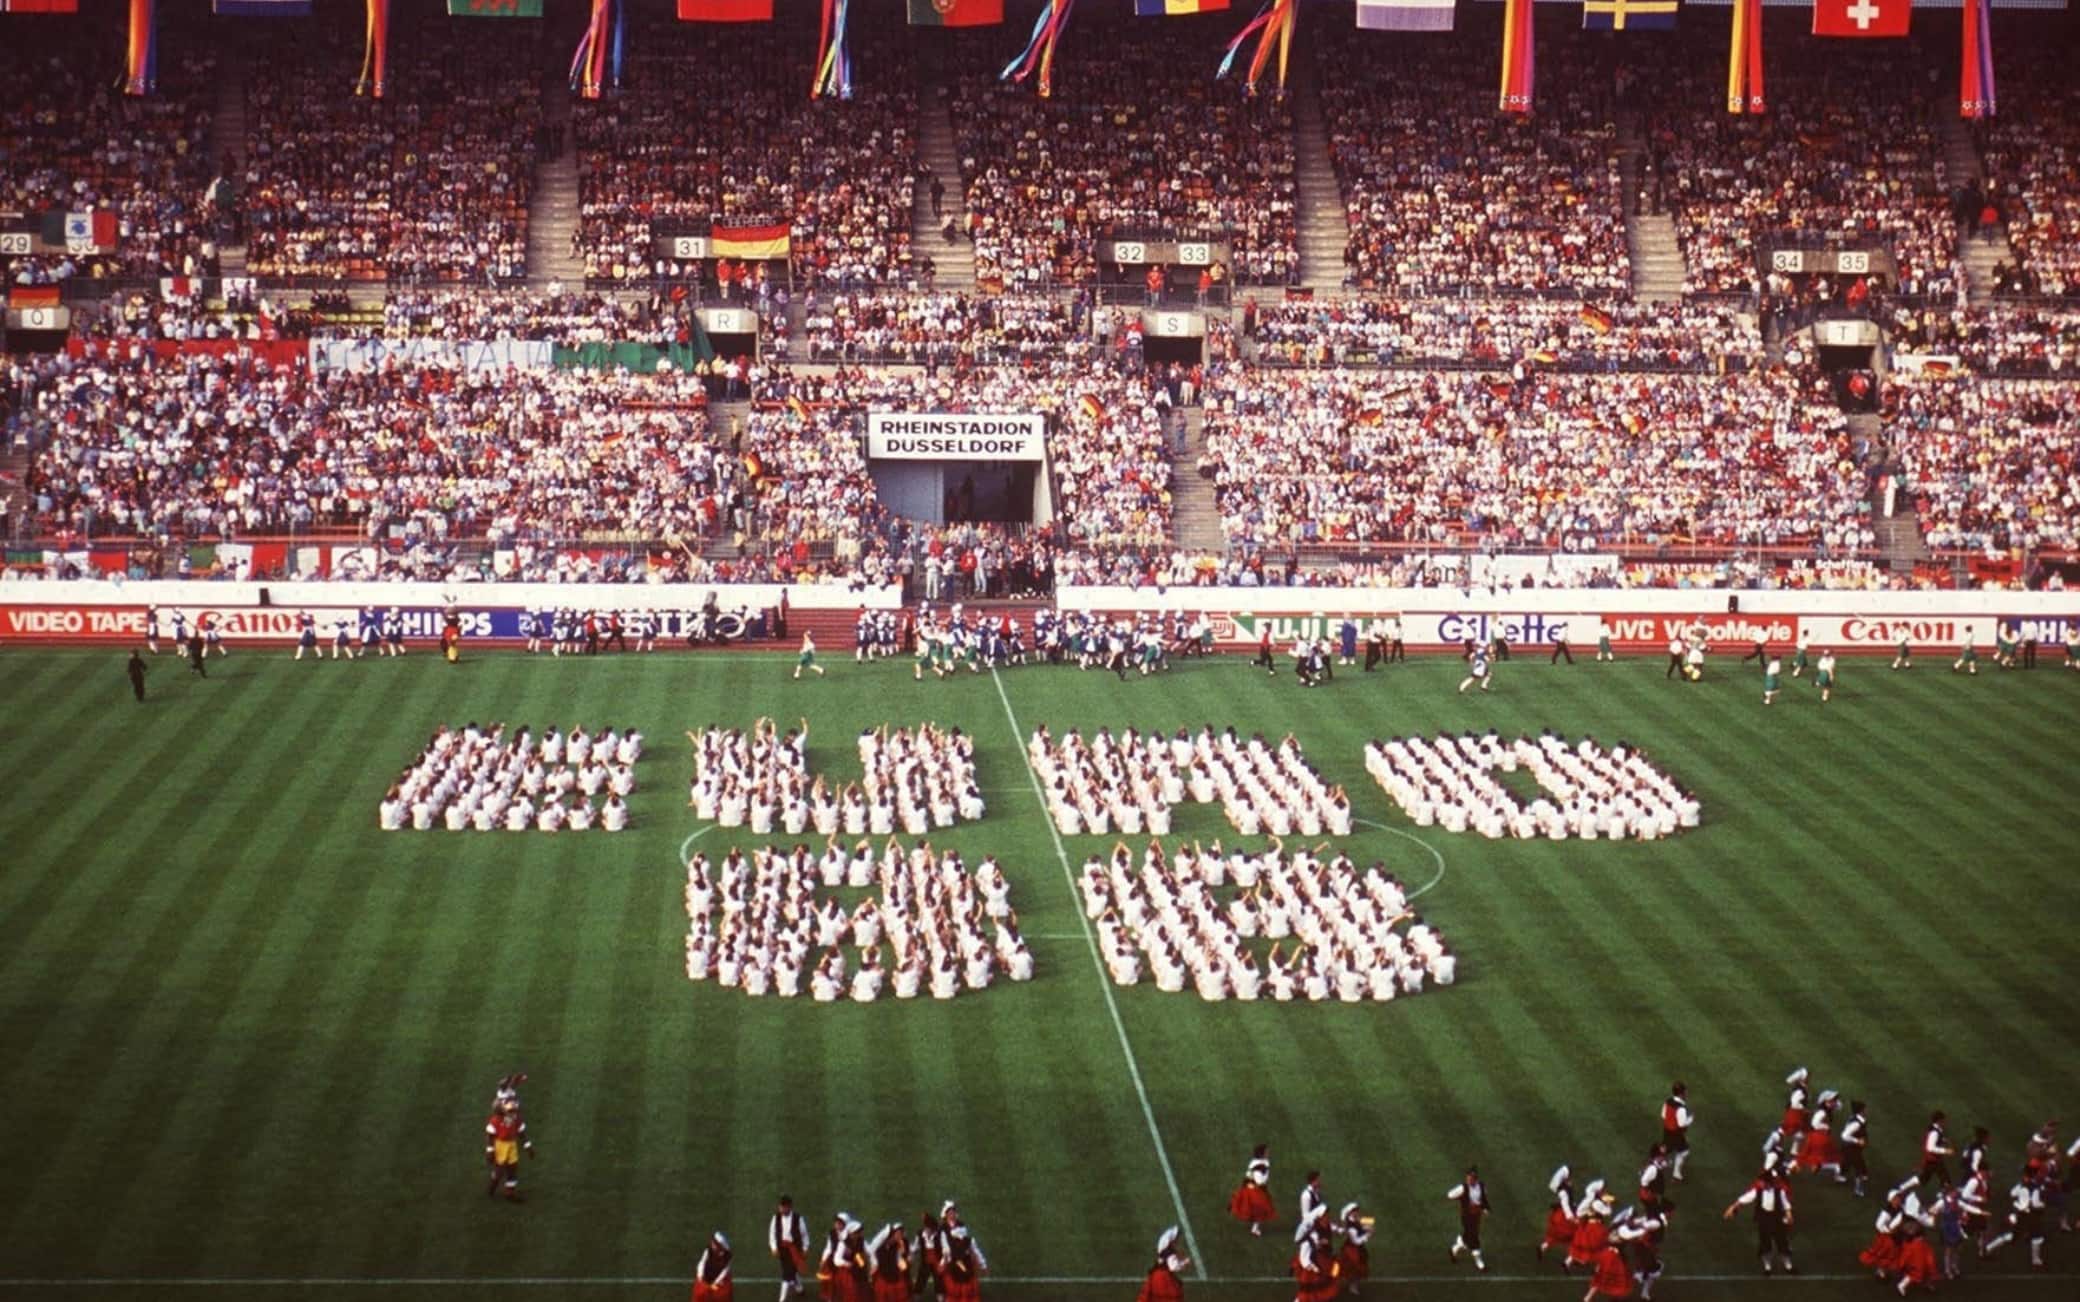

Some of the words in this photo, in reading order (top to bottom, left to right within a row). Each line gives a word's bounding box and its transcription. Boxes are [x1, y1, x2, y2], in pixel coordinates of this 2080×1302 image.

[3, 236, 28, 252] 29
[680, 240, 700, 255] 31
[1118, 245, 1141, 260] 32
[1183, 246, 1206, 261] 33
[1776, 255, 1798, 269] 34
[1842, 257, 1865, 271] 35
[31, 309, 44, 326] Q
[717, 313, 730, 328] R
[1167, 317, 1178, 332] S
[1838, 325, 1847, 340] T
[880, 421, 1033, 435] RHEINSTADION
[8, 611, 84, 632] VIDEO
[86, 611, 148, 632] TAPE
[1608, 619, 1656, 641] JVC
